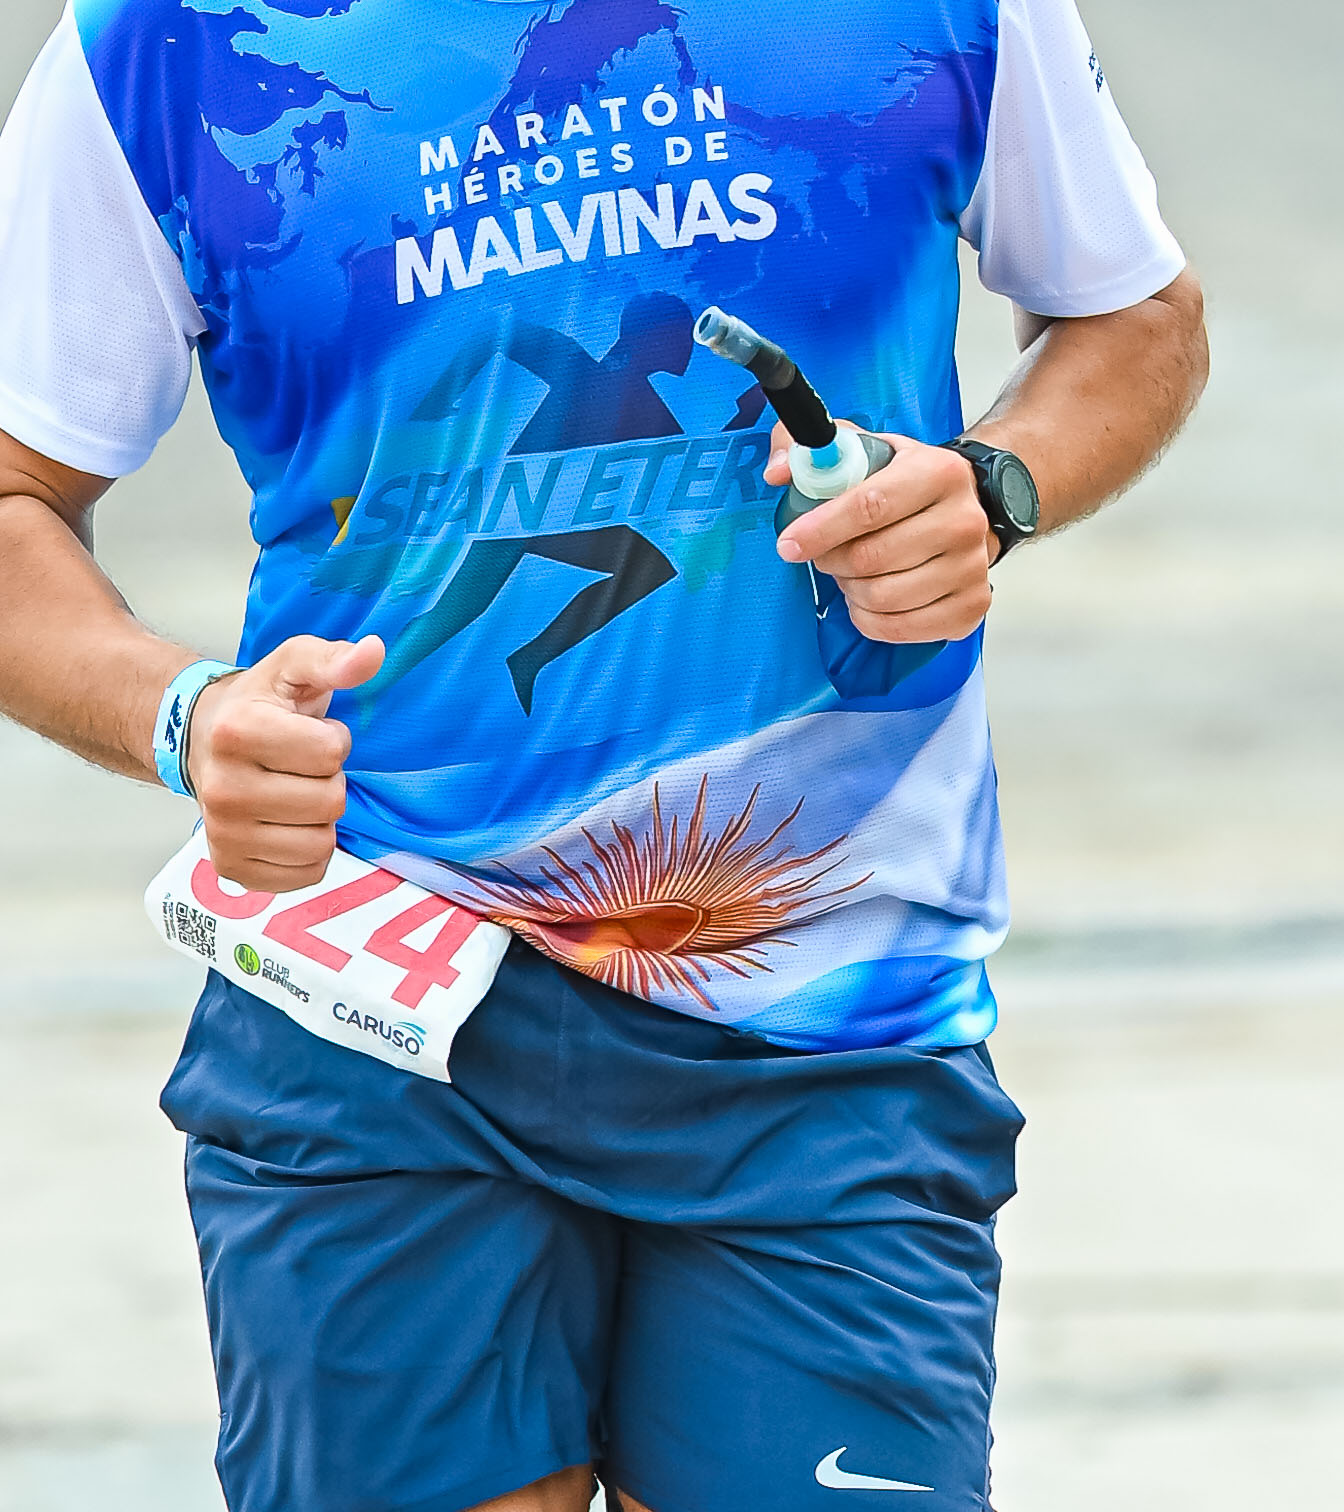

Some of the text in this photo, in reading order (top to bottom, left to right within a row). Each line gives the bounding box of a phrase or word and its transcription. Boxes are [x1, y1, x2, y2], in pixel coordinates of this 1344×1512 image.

[419, 83, 727, 177] MARATÓN
[423, 130, 730, 216] HÉROES DE
[394, 172, 778, 305] MALVINAS
[263, 958, 290, 979] CLUB
[332, 1002, 420, 1056] CARUSO
